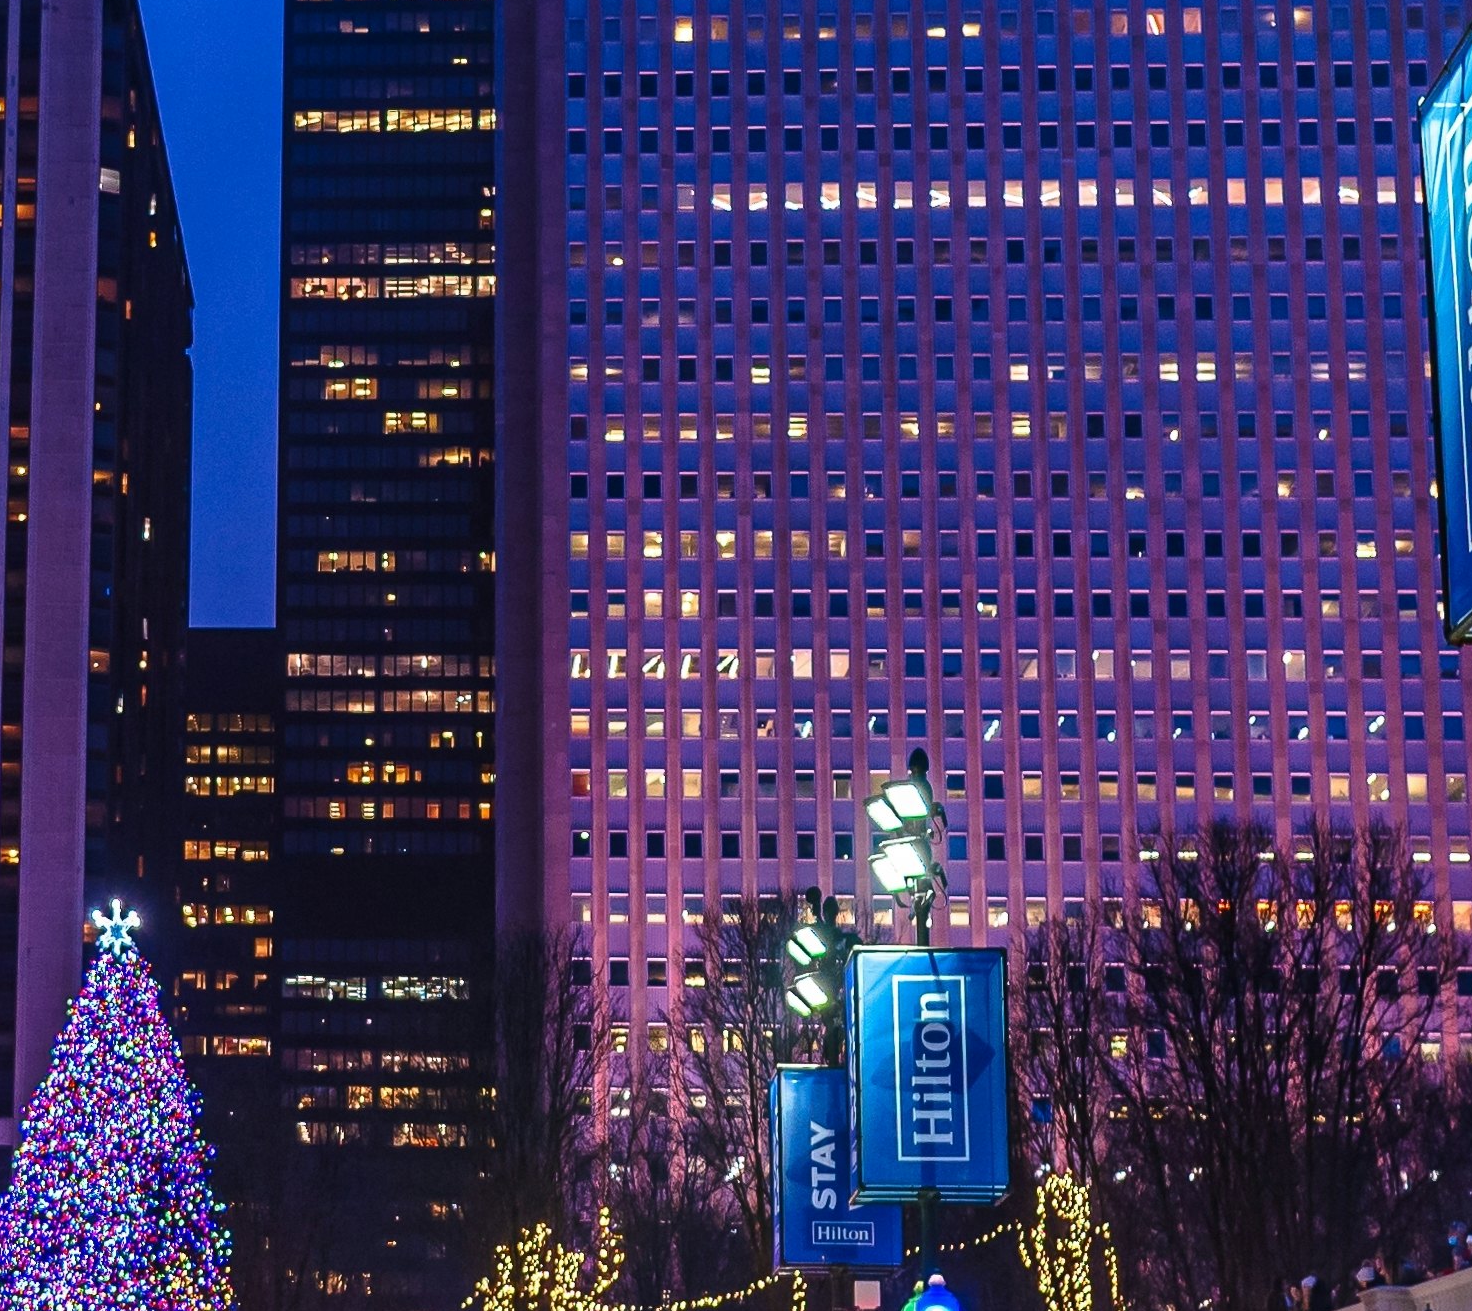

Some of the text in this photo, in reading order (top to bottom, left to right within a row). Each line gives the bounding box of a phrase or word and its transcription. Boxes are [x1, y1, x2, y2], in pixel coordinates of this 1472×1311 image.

[913, 990, 954, 1146] Hilton
[810, 1120, 837, 1210] STAY
[817, 1225, 869, 1242] Hilton
